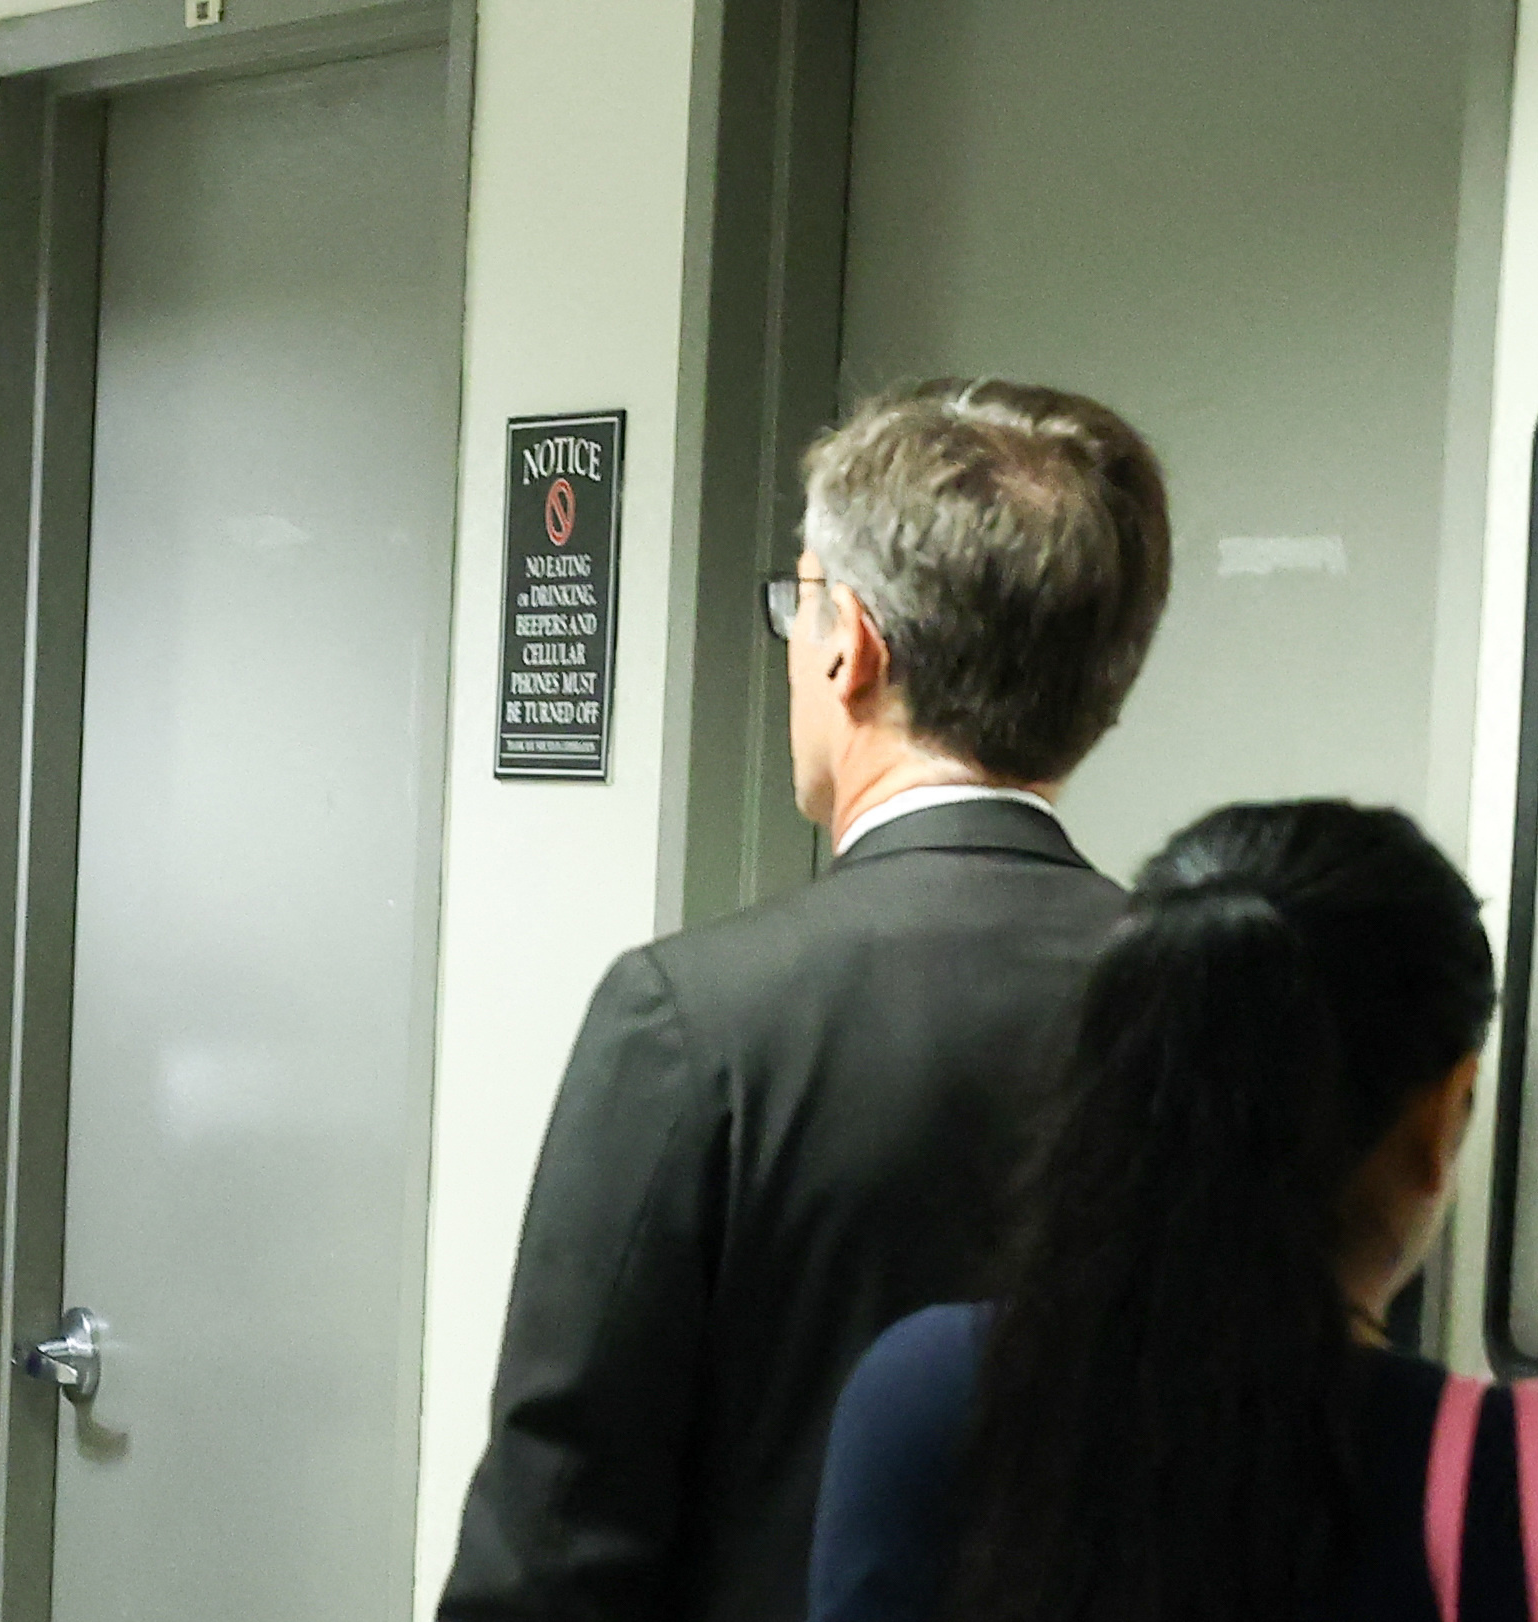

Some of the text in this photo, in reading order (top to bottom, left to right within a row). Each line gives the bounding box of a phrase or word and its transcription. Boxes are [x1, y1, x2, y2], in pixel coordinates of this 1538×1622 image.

[523, 437, 602, 485] NOTICE
[525, 553, 592, 578] NO EATING
[516, 612, 598, 636] BEEPERS AND
[522, 642, 586, 666] CELLULAR
[510, 671, 598, 695] PHONES MUST
[505, 700, 600, 724] BE TURNED OFF
